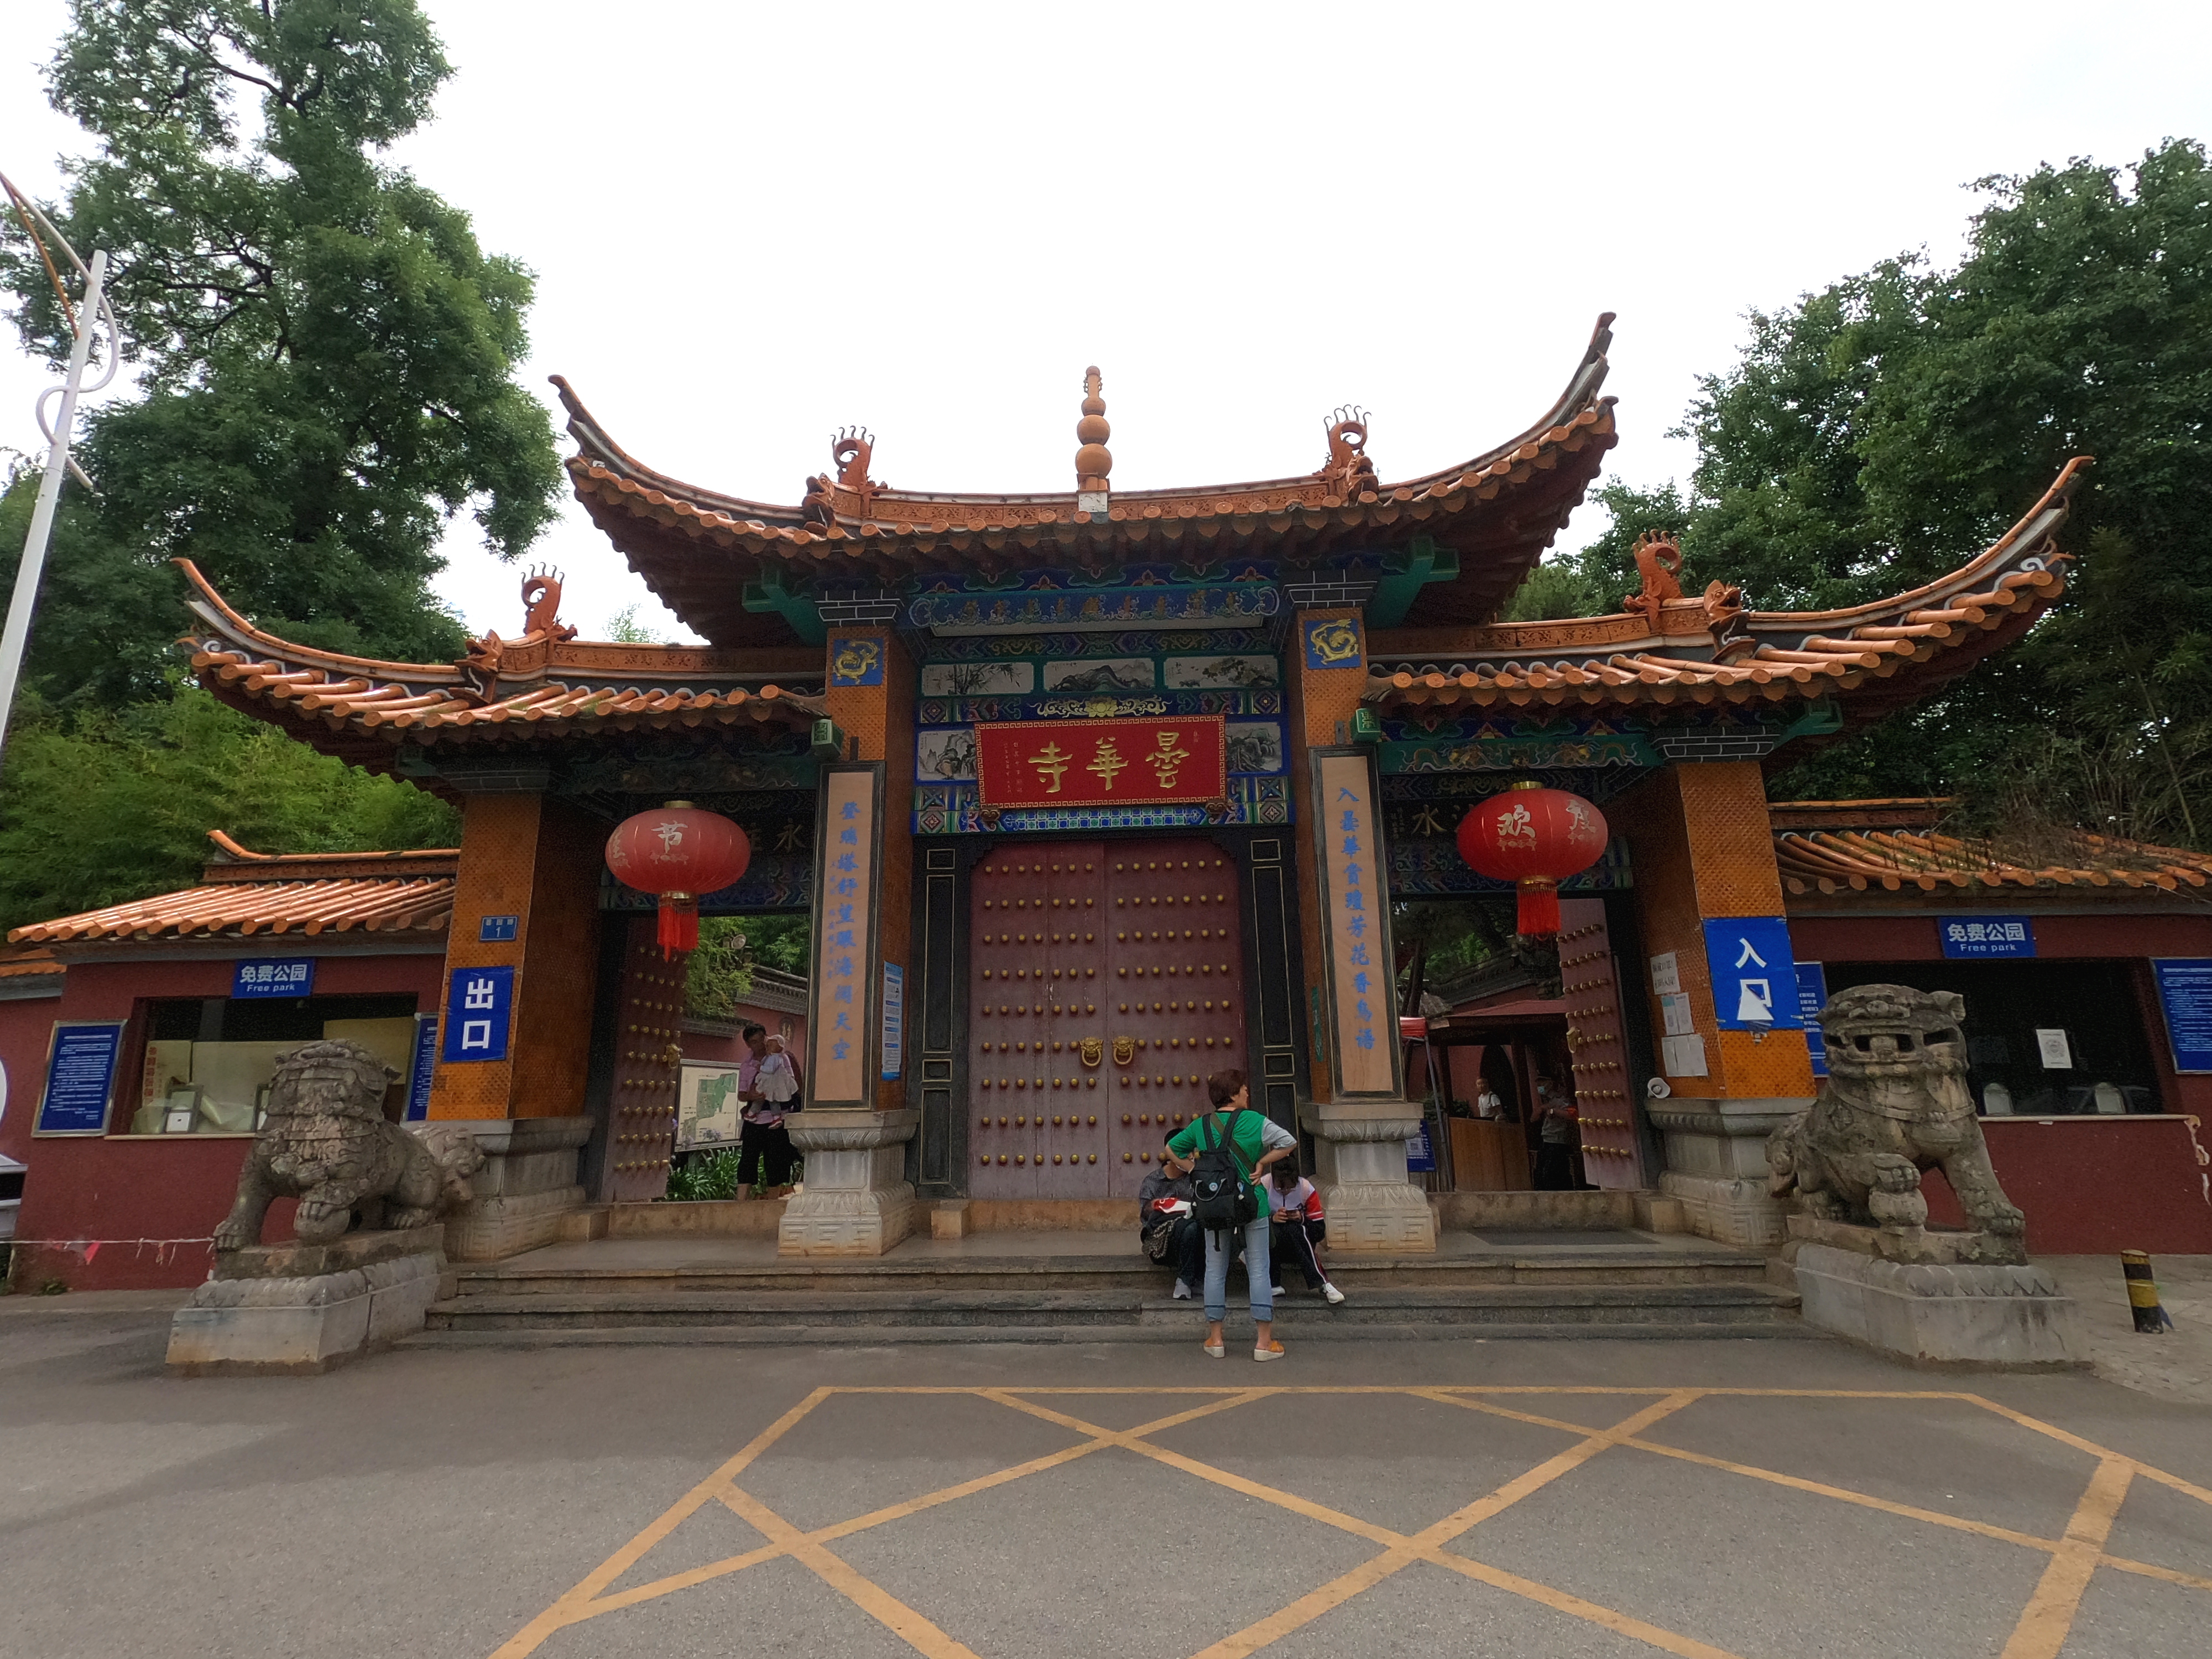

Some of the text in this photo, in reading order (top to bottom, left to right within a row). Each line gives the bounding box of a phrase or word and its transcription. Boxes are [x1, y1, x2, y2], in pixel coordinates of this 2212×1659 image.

[495, 926, 500, 938] 1
[1947, 922, 2026, 942] 免费公园
[1991, 943, 2017, 952] park
[239, 963, 307, 983] 免费公园
[273, 983, 295, 992] park
[461, 978, 494, 1050] 出口
